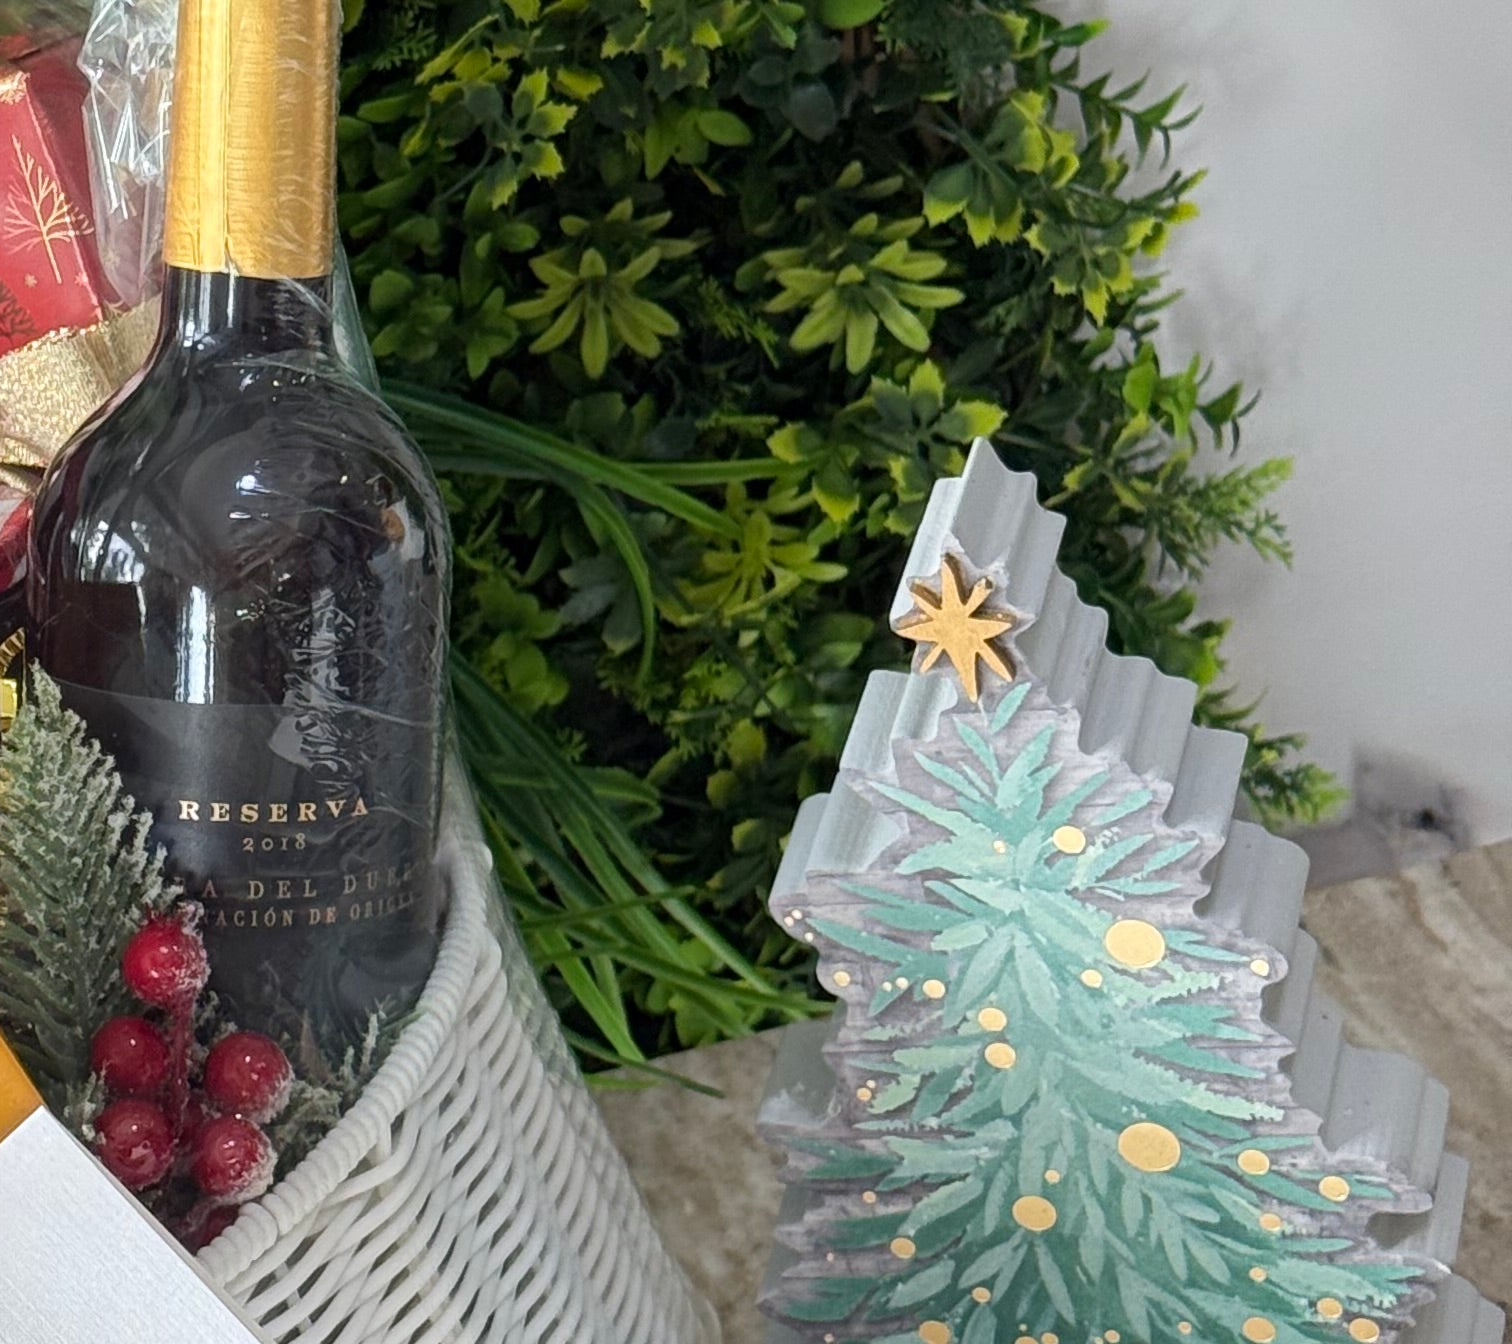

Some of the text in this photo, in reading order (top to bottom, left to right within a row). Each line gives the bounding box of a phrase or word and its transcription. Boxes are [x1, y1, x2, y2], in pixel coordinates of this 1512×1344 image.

[177, 796, 369, 824] RESERVA
[242, 832, 307, 853] 2018
[247, 878, 318, 901] DEL
[308, 906, 337, 925] DE
